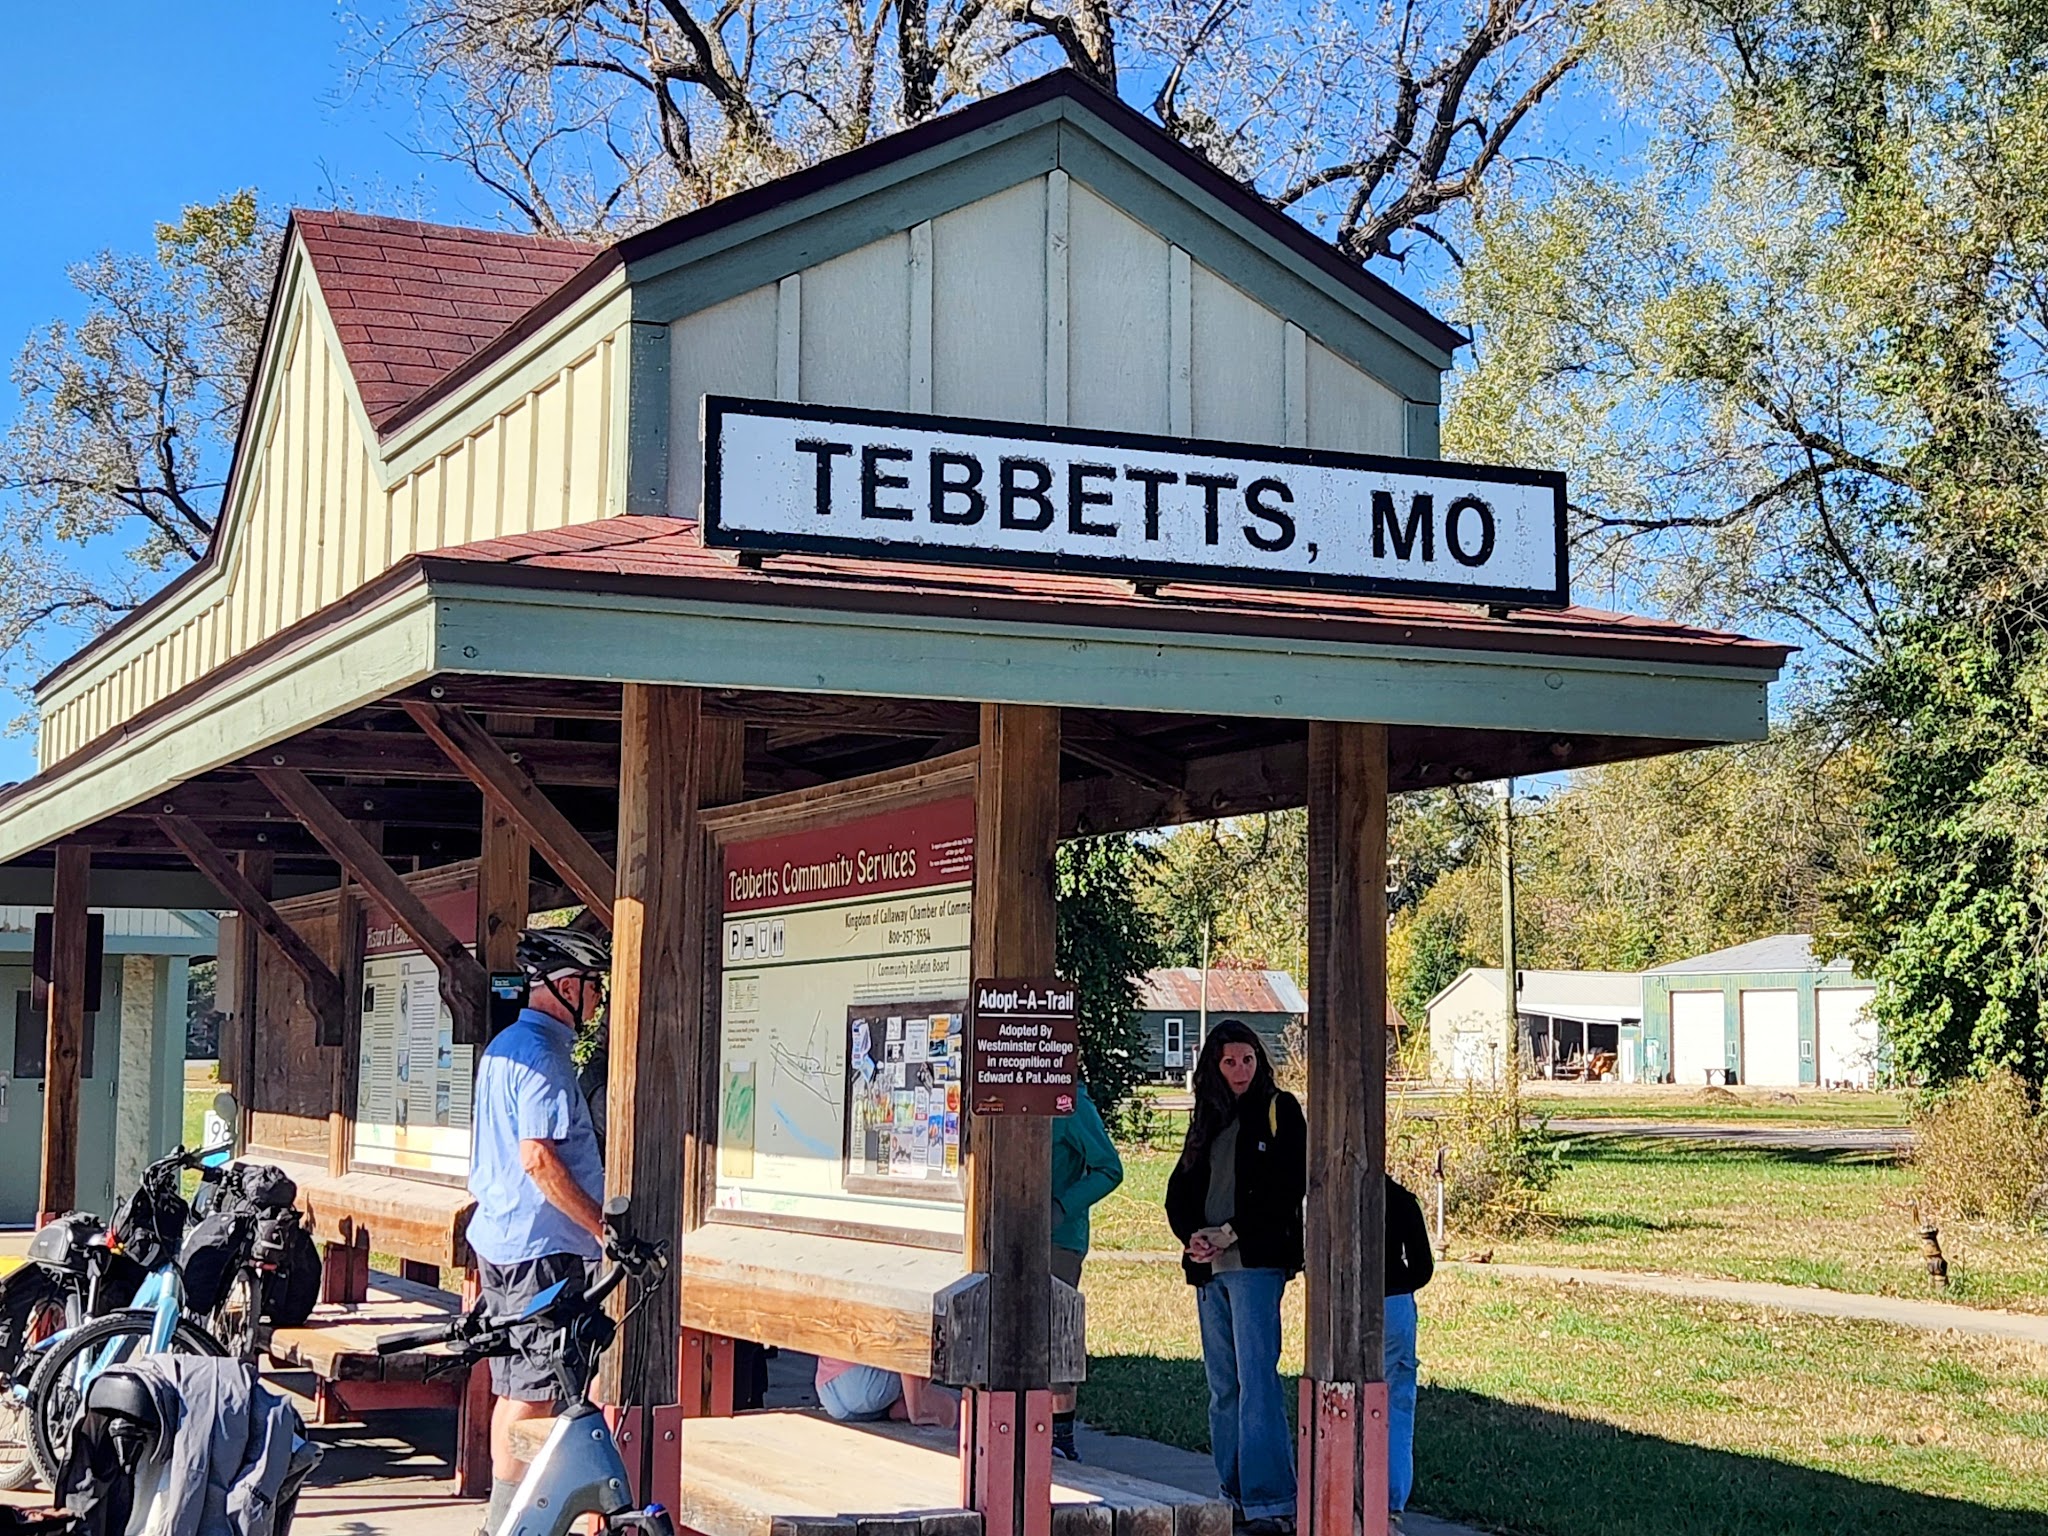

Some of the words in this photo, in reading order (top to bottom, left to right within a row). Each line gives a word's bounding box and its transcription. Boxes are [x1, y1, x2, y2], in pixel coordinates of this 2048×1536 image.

[795, 439, 1319, 563] TEBBETTS,
[1370, 489, 1496, 567] MO
[728, 868, 779, 902] Tebbetts
[782, 852, 853, 895] Community
[856, 844, 916, 885] Services
[845, 911, 871, 931] Kingdom
[872, 908, 879, 925] of
[880, 906, 908, 925] Callaway
[909, 902, 938, 921] Chamber
[939, 900, 946, 918] of
[947, 900, 971, 916] Comme
[877, 960, 908, 979] Community
[909, 958, 931, 975] Bulletin
[932, 956, 950, 973] Board
[978, 988, 1074, 1013] Adopt-A-Trail
[998, 1023, 1038, 1039] Adopted
[1040, 1024, 1053, 1039] By
[977, 1039, 1037, 1052] Westminster
[1038, 1040, 1073, 1055] College
[987, 1055, 997, 1067] in
[998, 1055, 1051, 1070] recognition
[1053, 1056, 1064, 1068] of
[977, 1070, 1014, 1083] Edward
[1015, 1071, 1024, 1083] &
[1025, 1072, 1042, 1084] Pat
[1043, 1072, 1072, 1084] Jones
